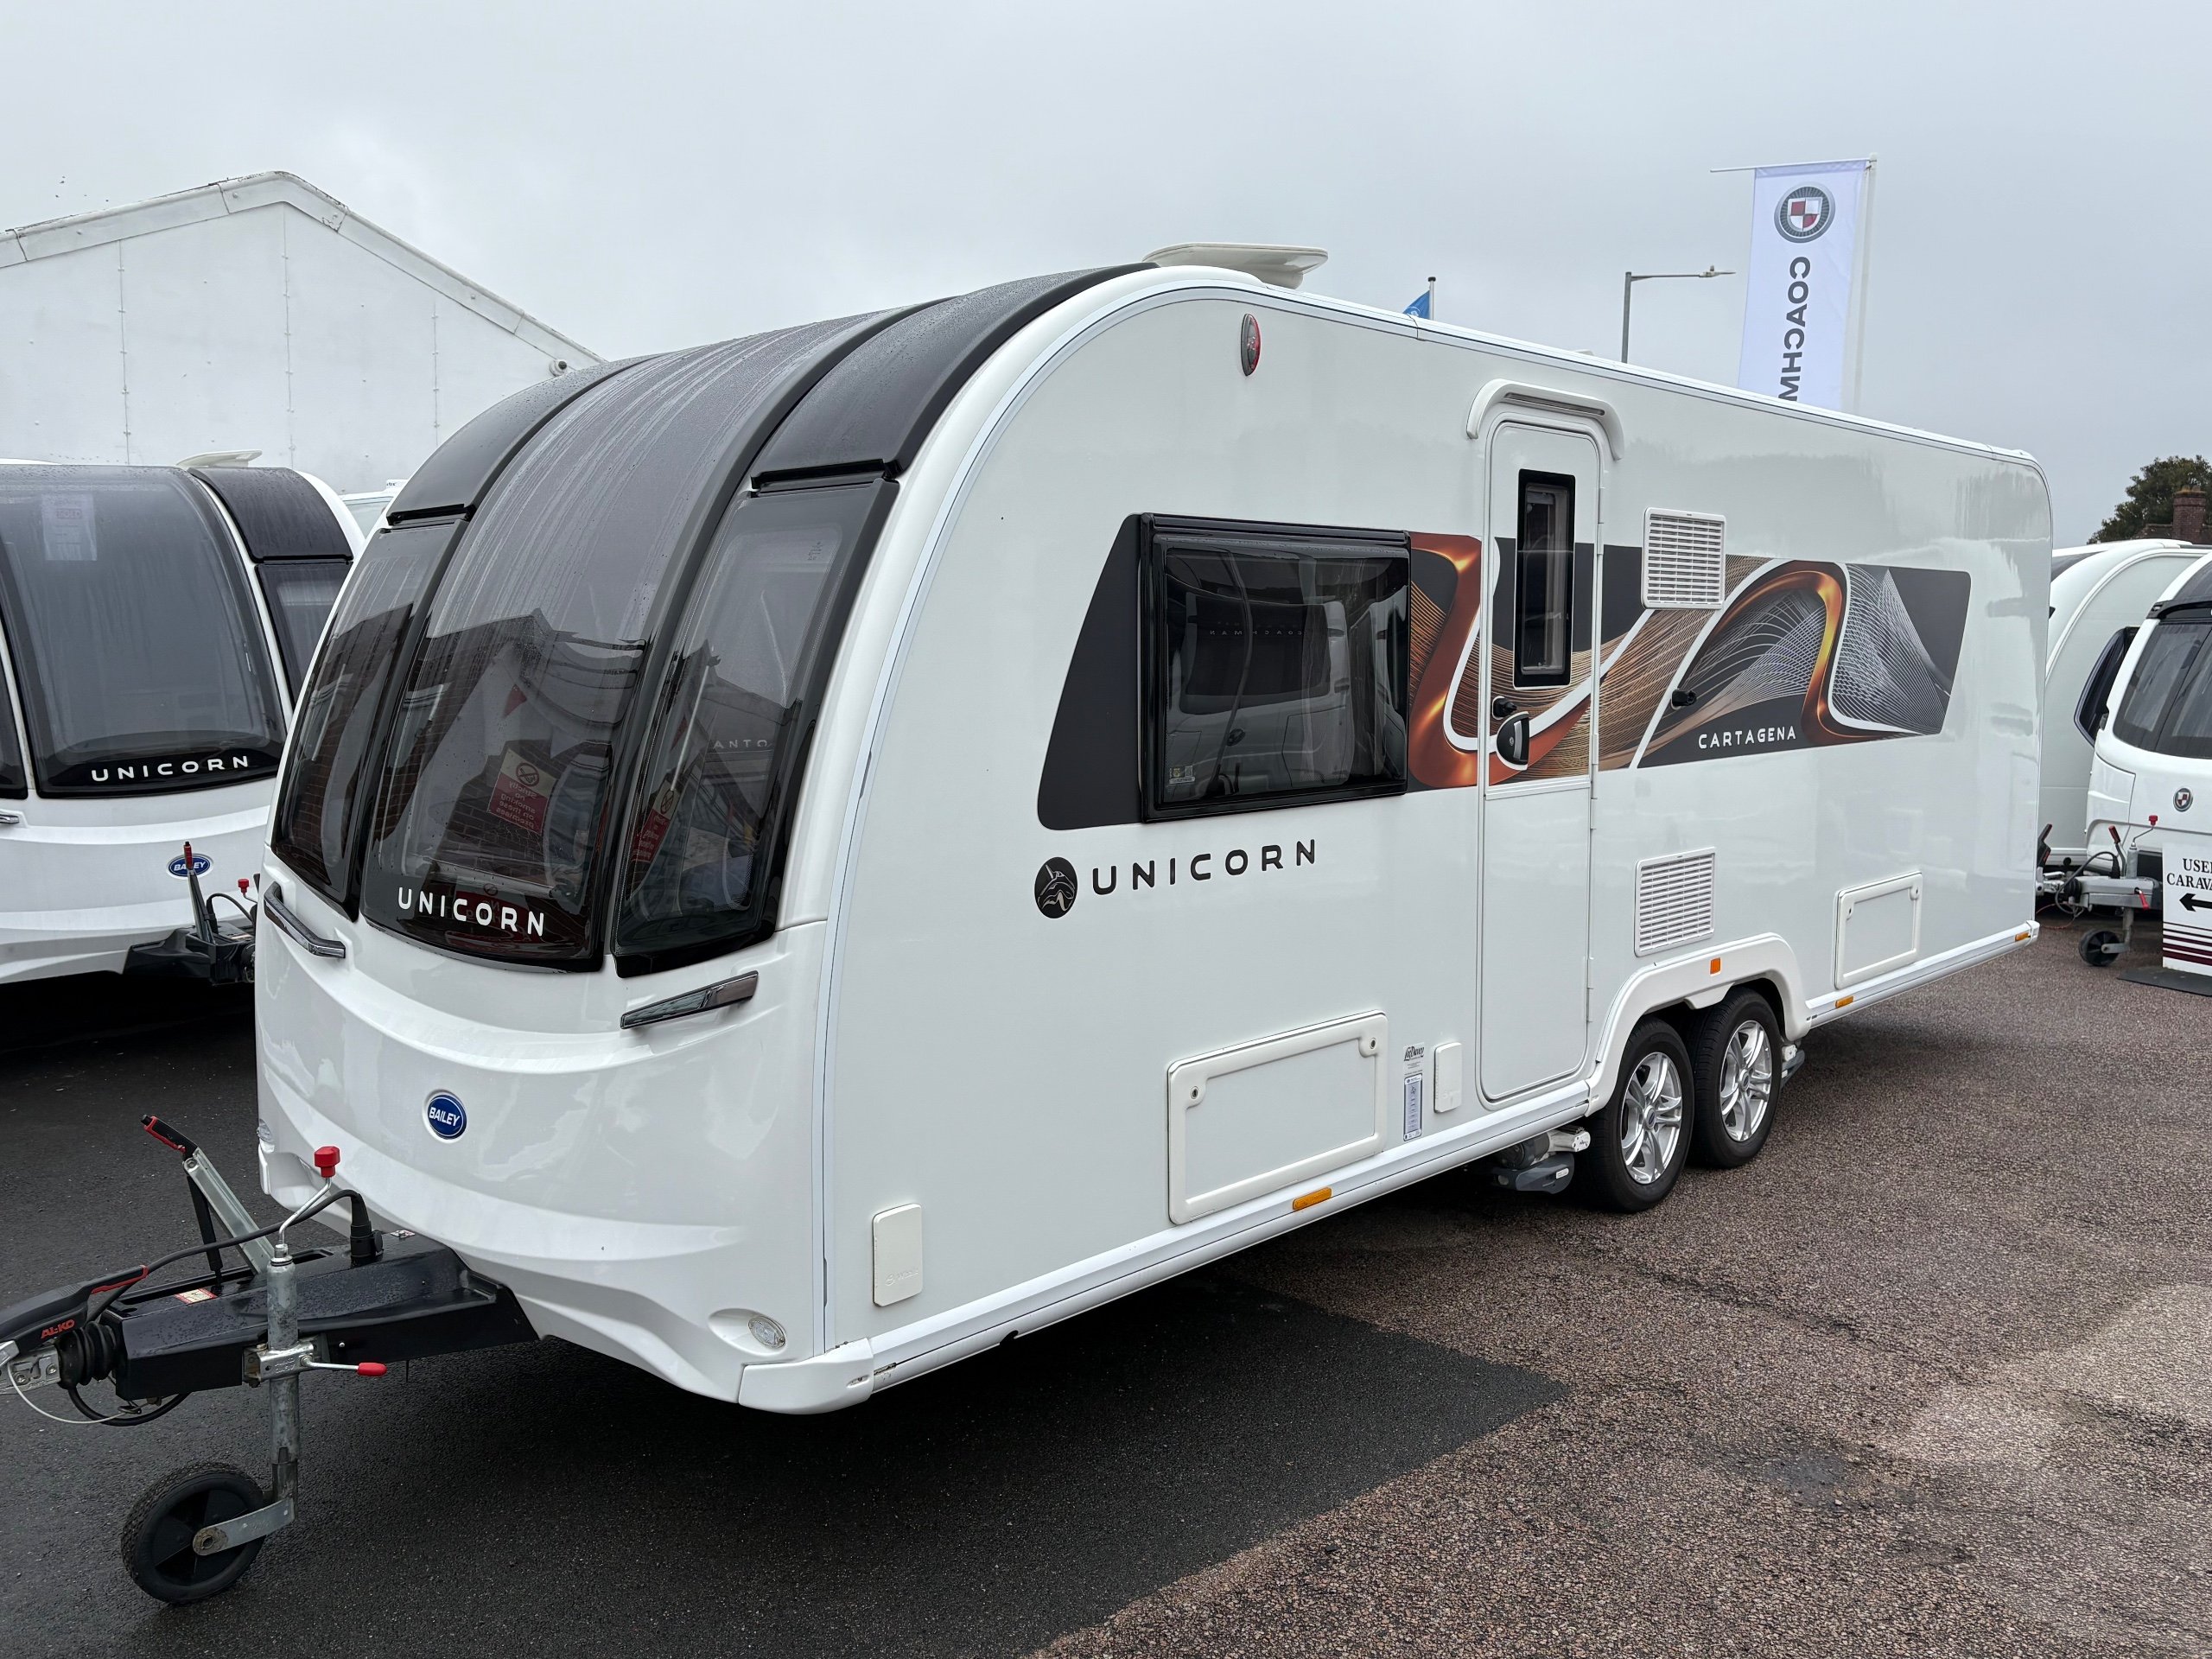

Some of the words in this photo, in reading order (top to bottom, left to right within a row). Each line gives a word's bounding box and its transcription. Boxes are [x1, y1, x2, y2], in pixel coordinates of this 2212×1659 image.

[1698, 725, 1796, 749] CARTAGENA
[91, 755, 249, 782] UNICORN
[174, 861, 207, 872] BAEY
[1092, 839, 1316, 896] UNICORN
[2182, 857, 2212, 874] USE
[397, 887, 544, 937] UNICORN
[429, 1106, 461, 1127] BAILEY
